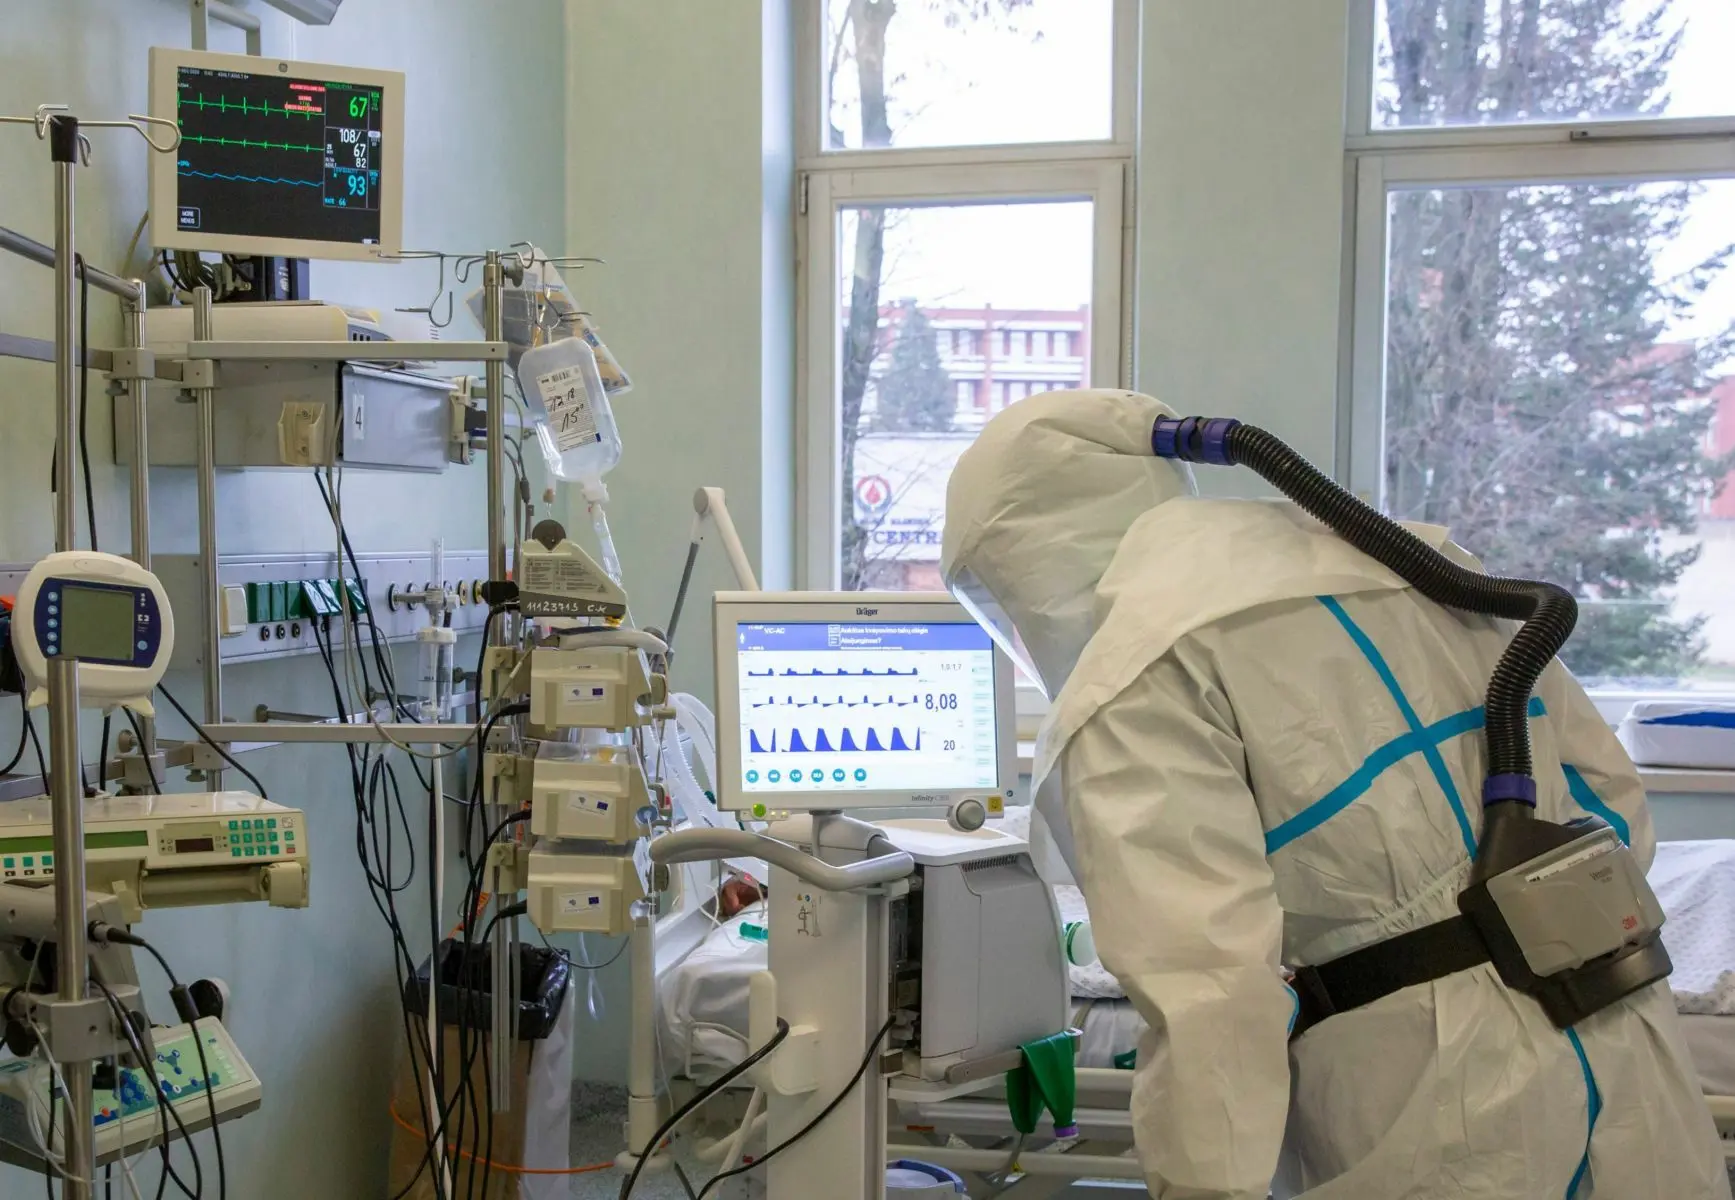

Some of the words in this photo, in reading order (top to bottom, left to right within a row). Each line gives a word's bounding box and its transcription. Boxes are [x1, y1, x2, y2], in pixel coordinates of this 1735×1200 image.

[349, 96, 368, 118] 67
[353, 143, 366, 158] 67
[355, 157, 367, 168] 82
[348, 174, 366, 196] 93
[355, 406, 362, 430] 4
[873, 531, 942, 544] CENTR
[925, 693, 958, 712] 8,08
[943, 740, 956, 751] 20
